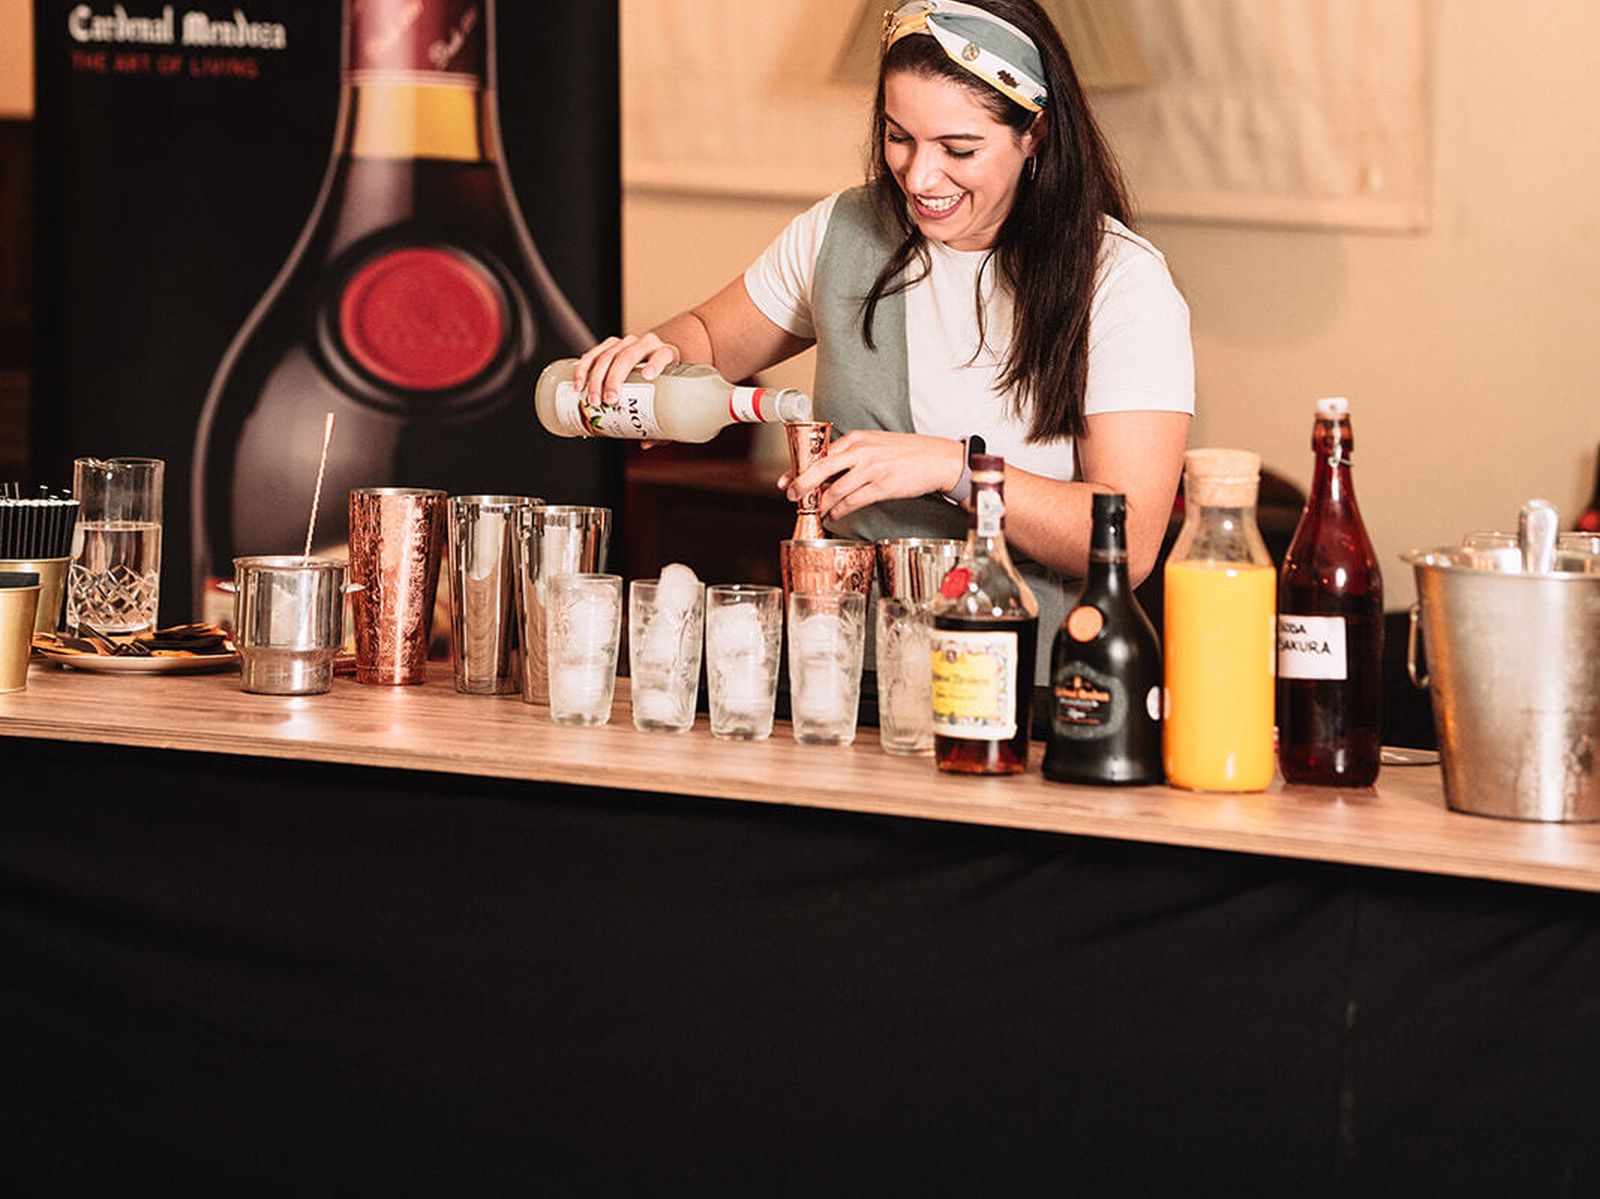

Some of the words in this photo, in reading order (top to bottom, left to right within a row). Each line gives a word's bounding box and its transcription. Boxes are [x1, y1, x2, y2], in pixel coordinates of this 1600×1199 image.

[68, 3, 175, 44] Cardenal
[181, 8, 287, 49] Mendoza
[71, 50, 107, 72] THE
[113, 52, 151, 74] ART
[155, 53, 183, 76] OF
[189, 56, 259, 80] LIVING
